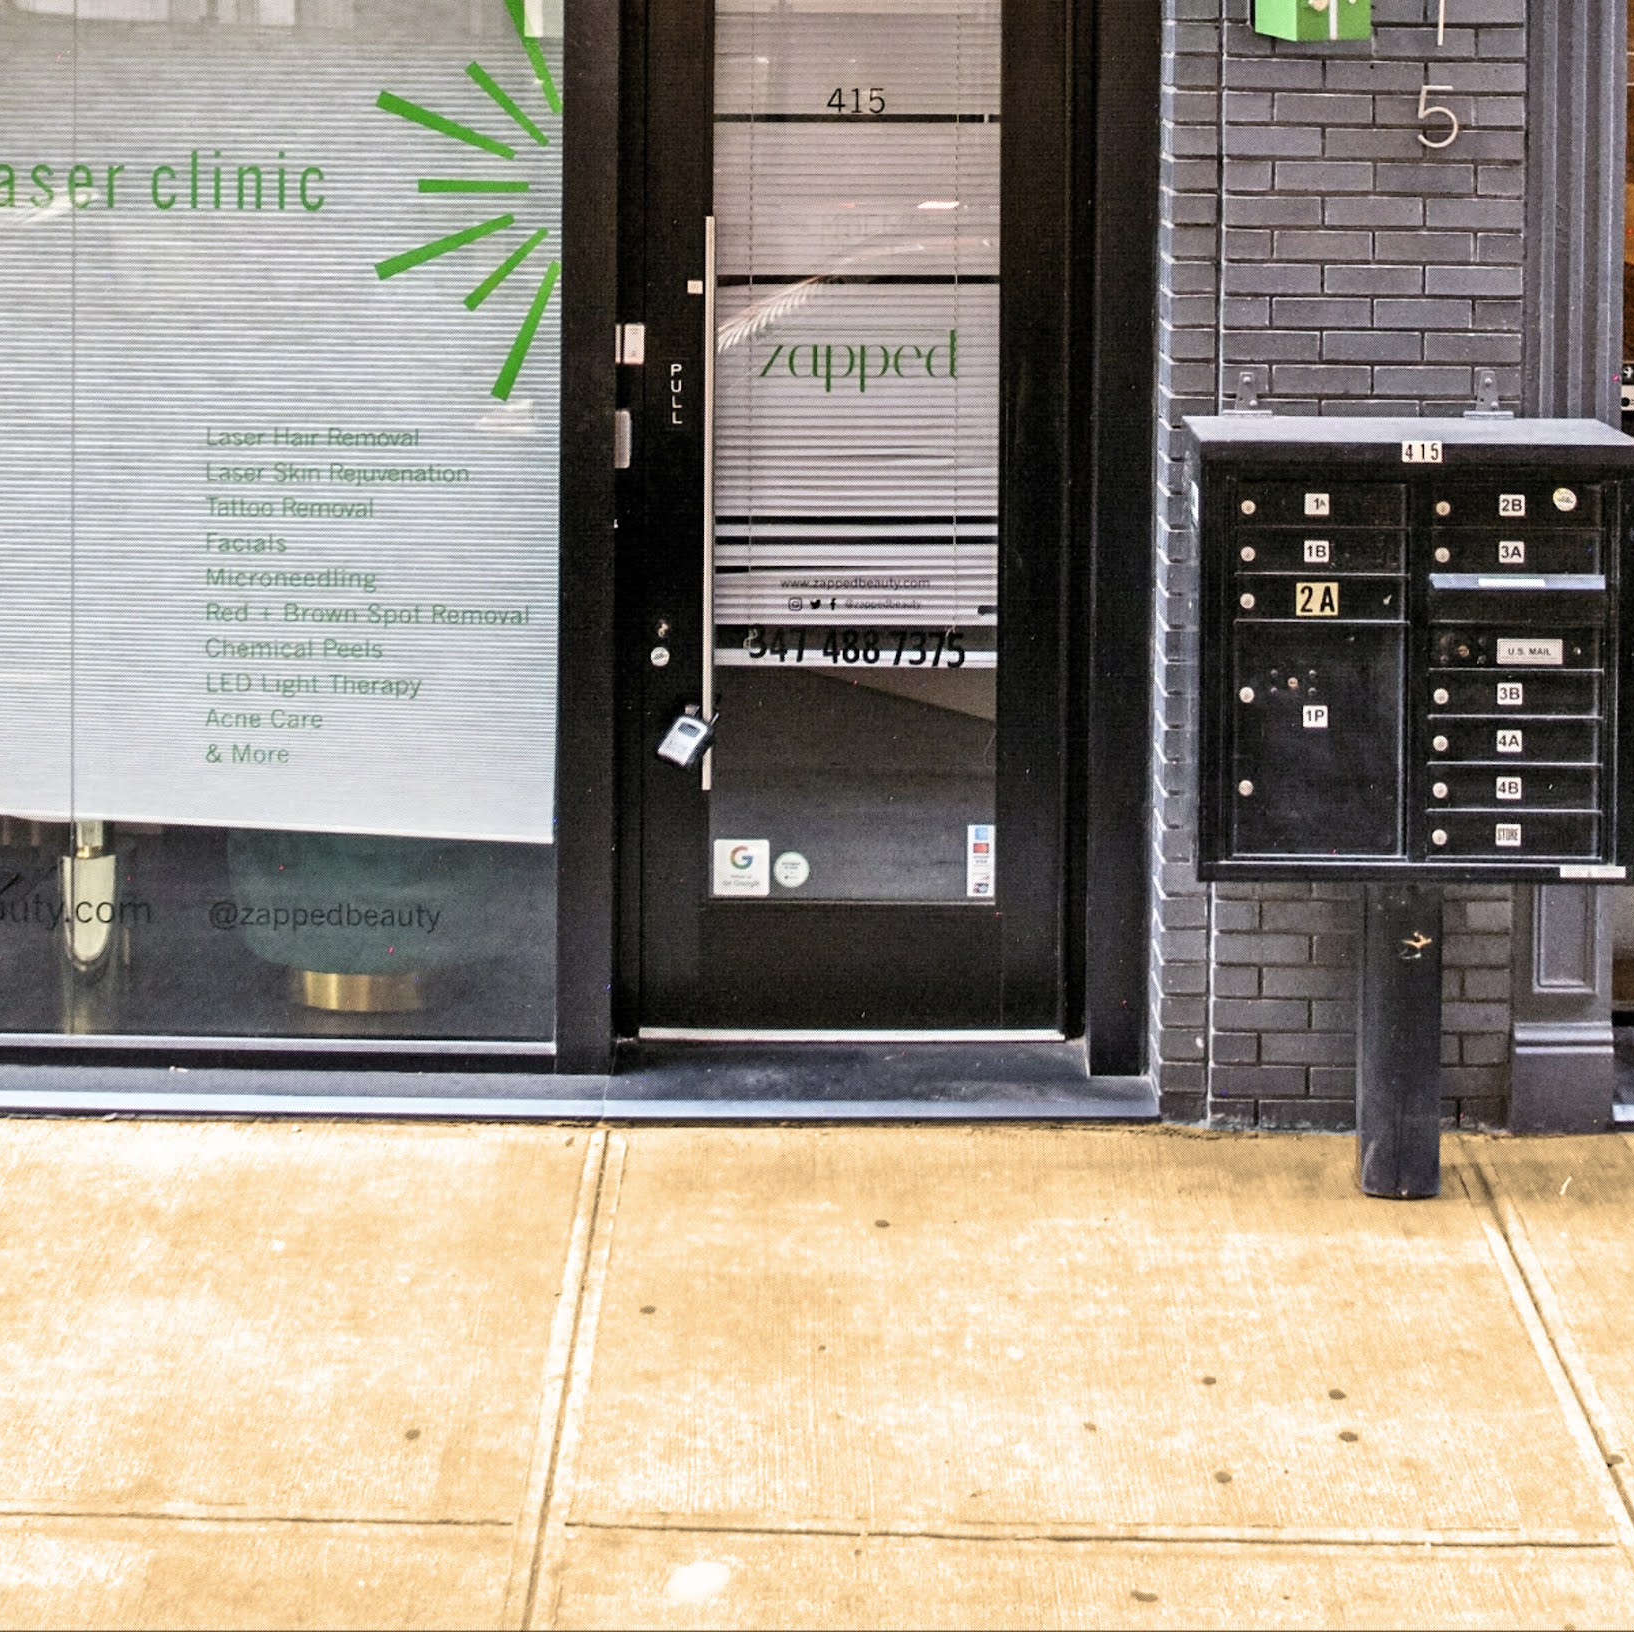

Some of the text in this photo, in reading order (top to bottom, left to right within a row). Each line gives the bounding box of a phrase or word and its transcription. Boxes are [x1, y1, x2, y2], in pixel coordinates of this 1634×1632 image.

[825, 87, 887, 114] 415
[150, 149, 327, 212] clinic
[758, 328, 958, 393] zapped
[670, 363, 683, 426] PULL
[205, 426, 420, 448] Laser Hair Removal
[1404, 443, 1441, 461] 415
[205, 462, 470, 487] Laser Skin Rejuvenation
[205, 496, 375, 519] Tattoo Removal
[1501, 498, 1523, 512] 2B
[205, 532, 288, 553] Facials
[1306, 544, 1327, 558] 1B
[1501, 545, 1522, 559] 3A
[205, 567, 377, 593] Microneedling
[780, 576, 931, 591] www.zappedbeauty.com
[205, 602, 530, 629] Red + Brown Spot Removal
[205, 637, 384, 659] Chemical Peels
[747, 623, 967, 669] 347 488 7375
[1528, 647, 1552, 657] MAIL
[205, 672, 422, 700] LED Light Therapy
[1499, 687, 1520, 701] 3B
[204, 708, 324, 730] Acne Care
[1305, 709, 1326, 724] 1P
[1498, 734, 1520, 748] 4A
[204, 743, 290, 764] & More
[1498, 780, 1519, 795] 4B
[208, 900, 443, 935] @zappedbeauty
